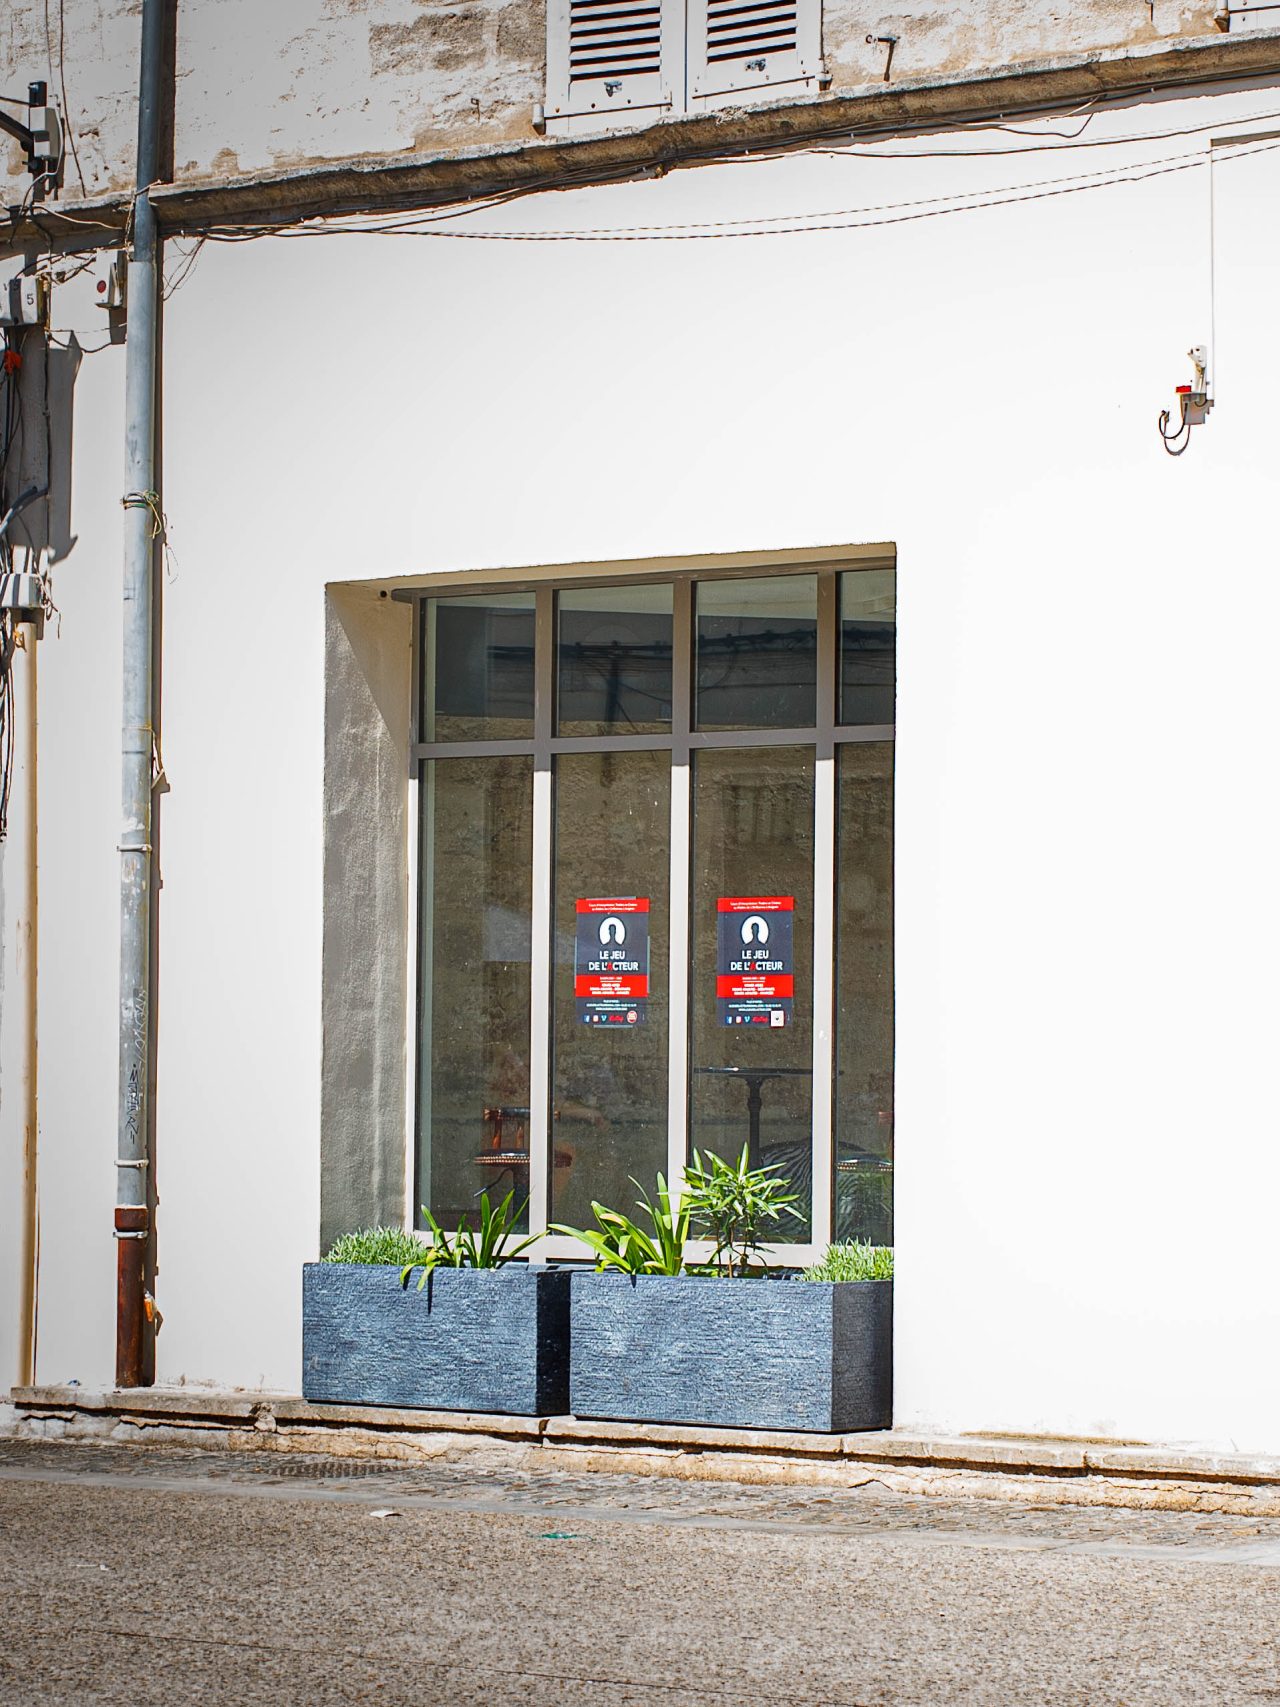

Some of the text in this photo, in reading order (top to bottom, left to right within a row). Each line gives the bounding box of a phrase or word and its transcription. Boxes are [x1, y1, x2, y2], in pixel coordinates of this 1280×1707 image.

[26, 293, 35, 306] 5
[599, 950, 625, 960] LE JEU
[741, 950, 769, 960] LE JEU
[588, 962, 639, 971] DE L'ACTEUR
[730, 961, 783, 971] DE L'ACTEUR
